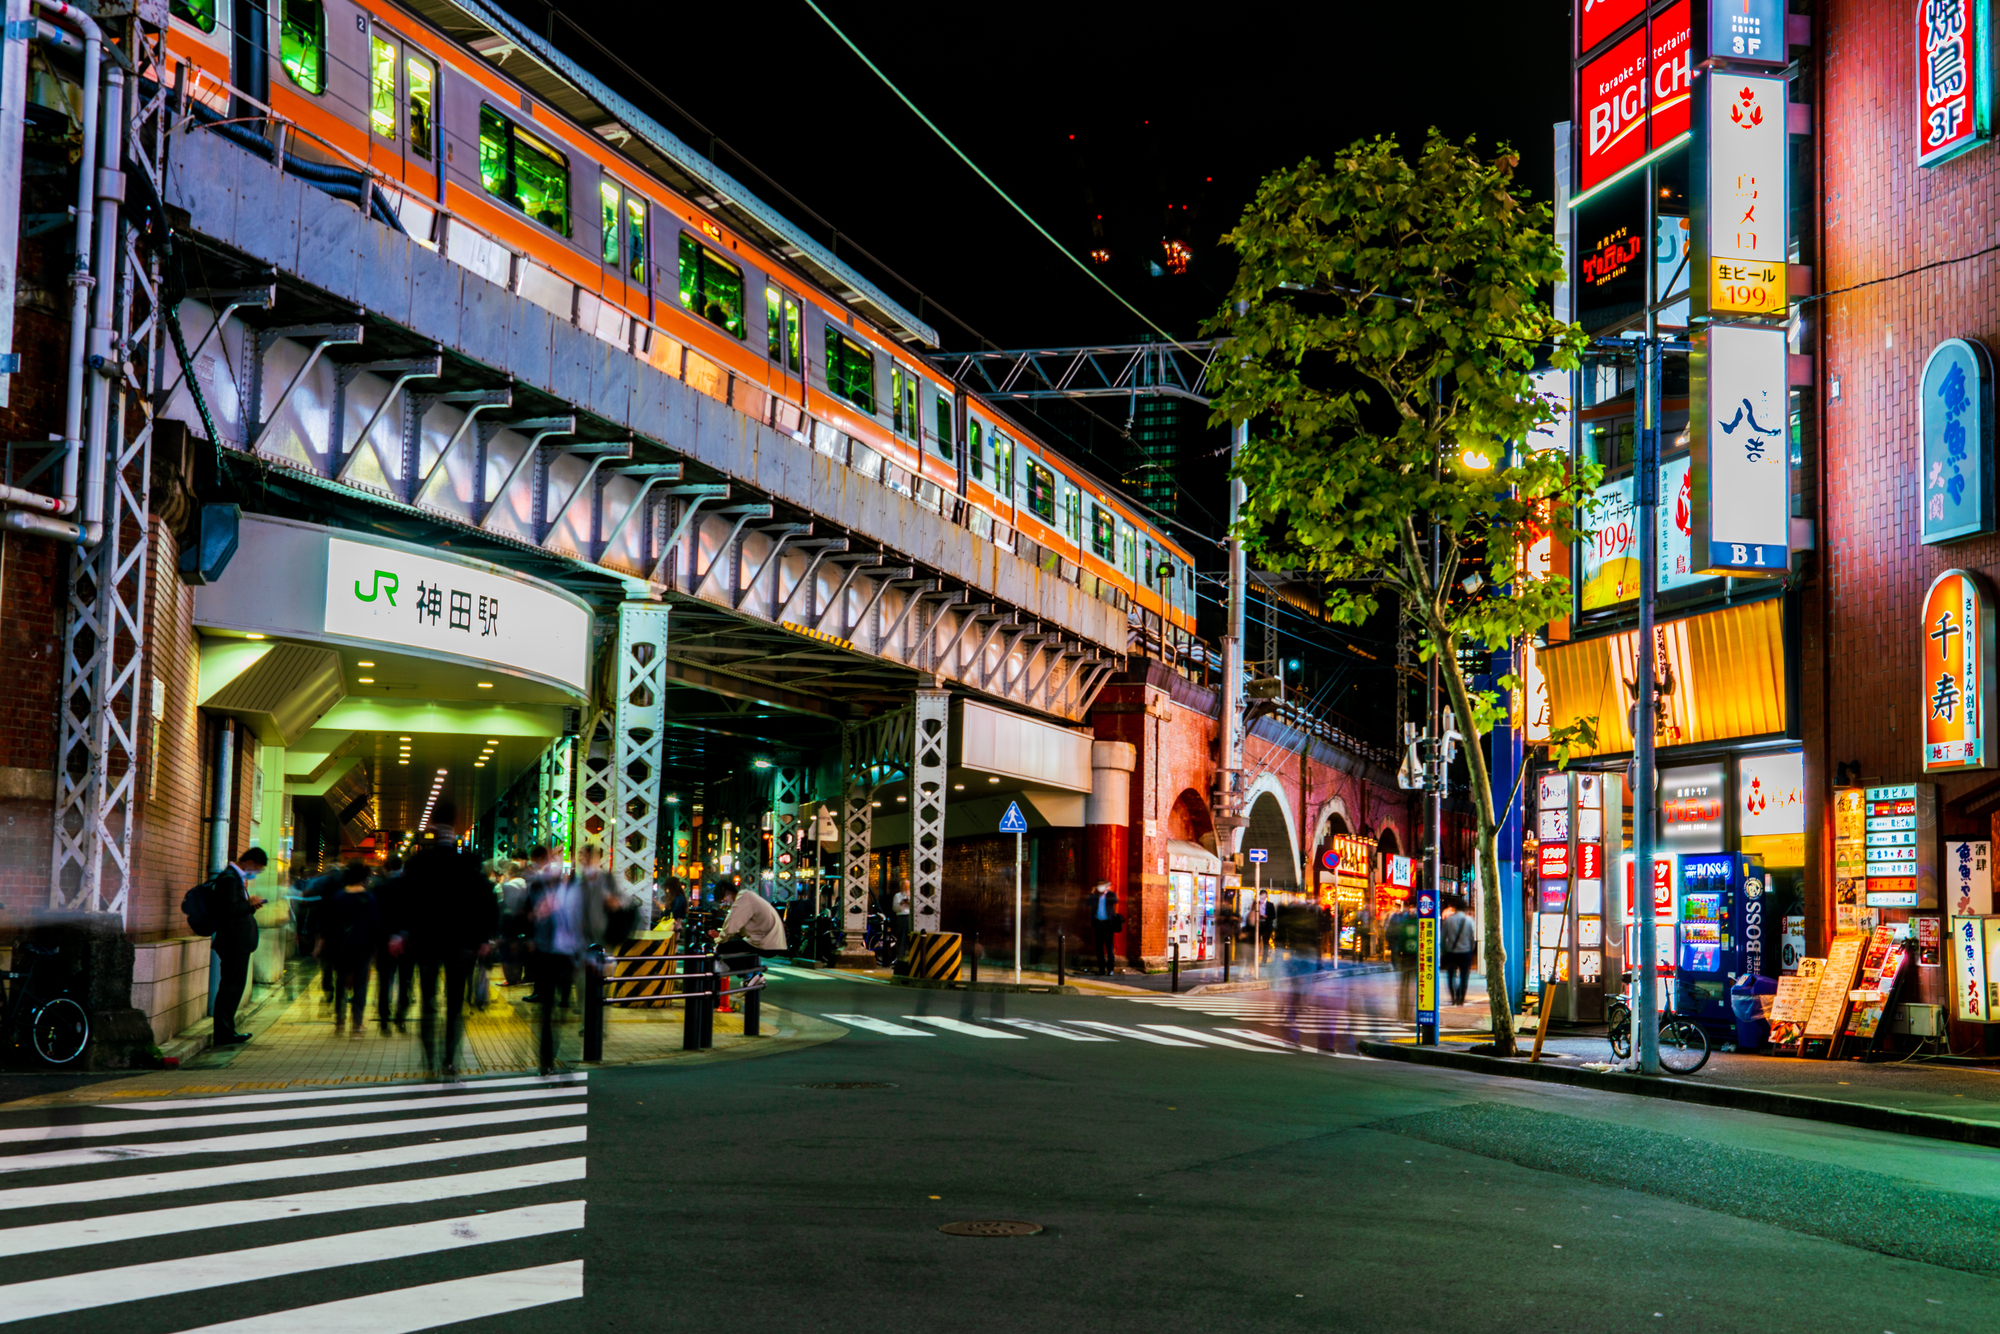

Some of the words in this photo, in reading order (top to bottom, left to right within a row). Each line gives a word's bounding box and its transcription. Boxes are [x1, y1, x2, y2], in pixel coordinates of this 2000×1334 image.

[357, 16, 366, 31] 2
[1732, 36, 1761, 55] 3F
[1926, 0, 1966, 106] 焼鳥
[1599, 63, 1634, 97] Karaoke
[1927, 95, 1966, 146] 3F
[1718, 264, 1776, 283] 生ビール
[1602, 491, 1622, 507] アサヒ
[1928, 461, 1945, 521] 大関
[1590, 504, 1637, 527] スーパードライ
[1731, 544, 1765, 566] B1
[354, 569, 399, 607] JR
[416, 579, 499, 637] 神田駅
[1930, 611, 1960, 724] 千寿
[1965, 598, 1975, 725] さらりーまん割烹
[1932, 743, 1975, 760] 地下一階
[1697, 862, 1721, 879] BOSS
[1746, 901, 1761, 953] BOSS
